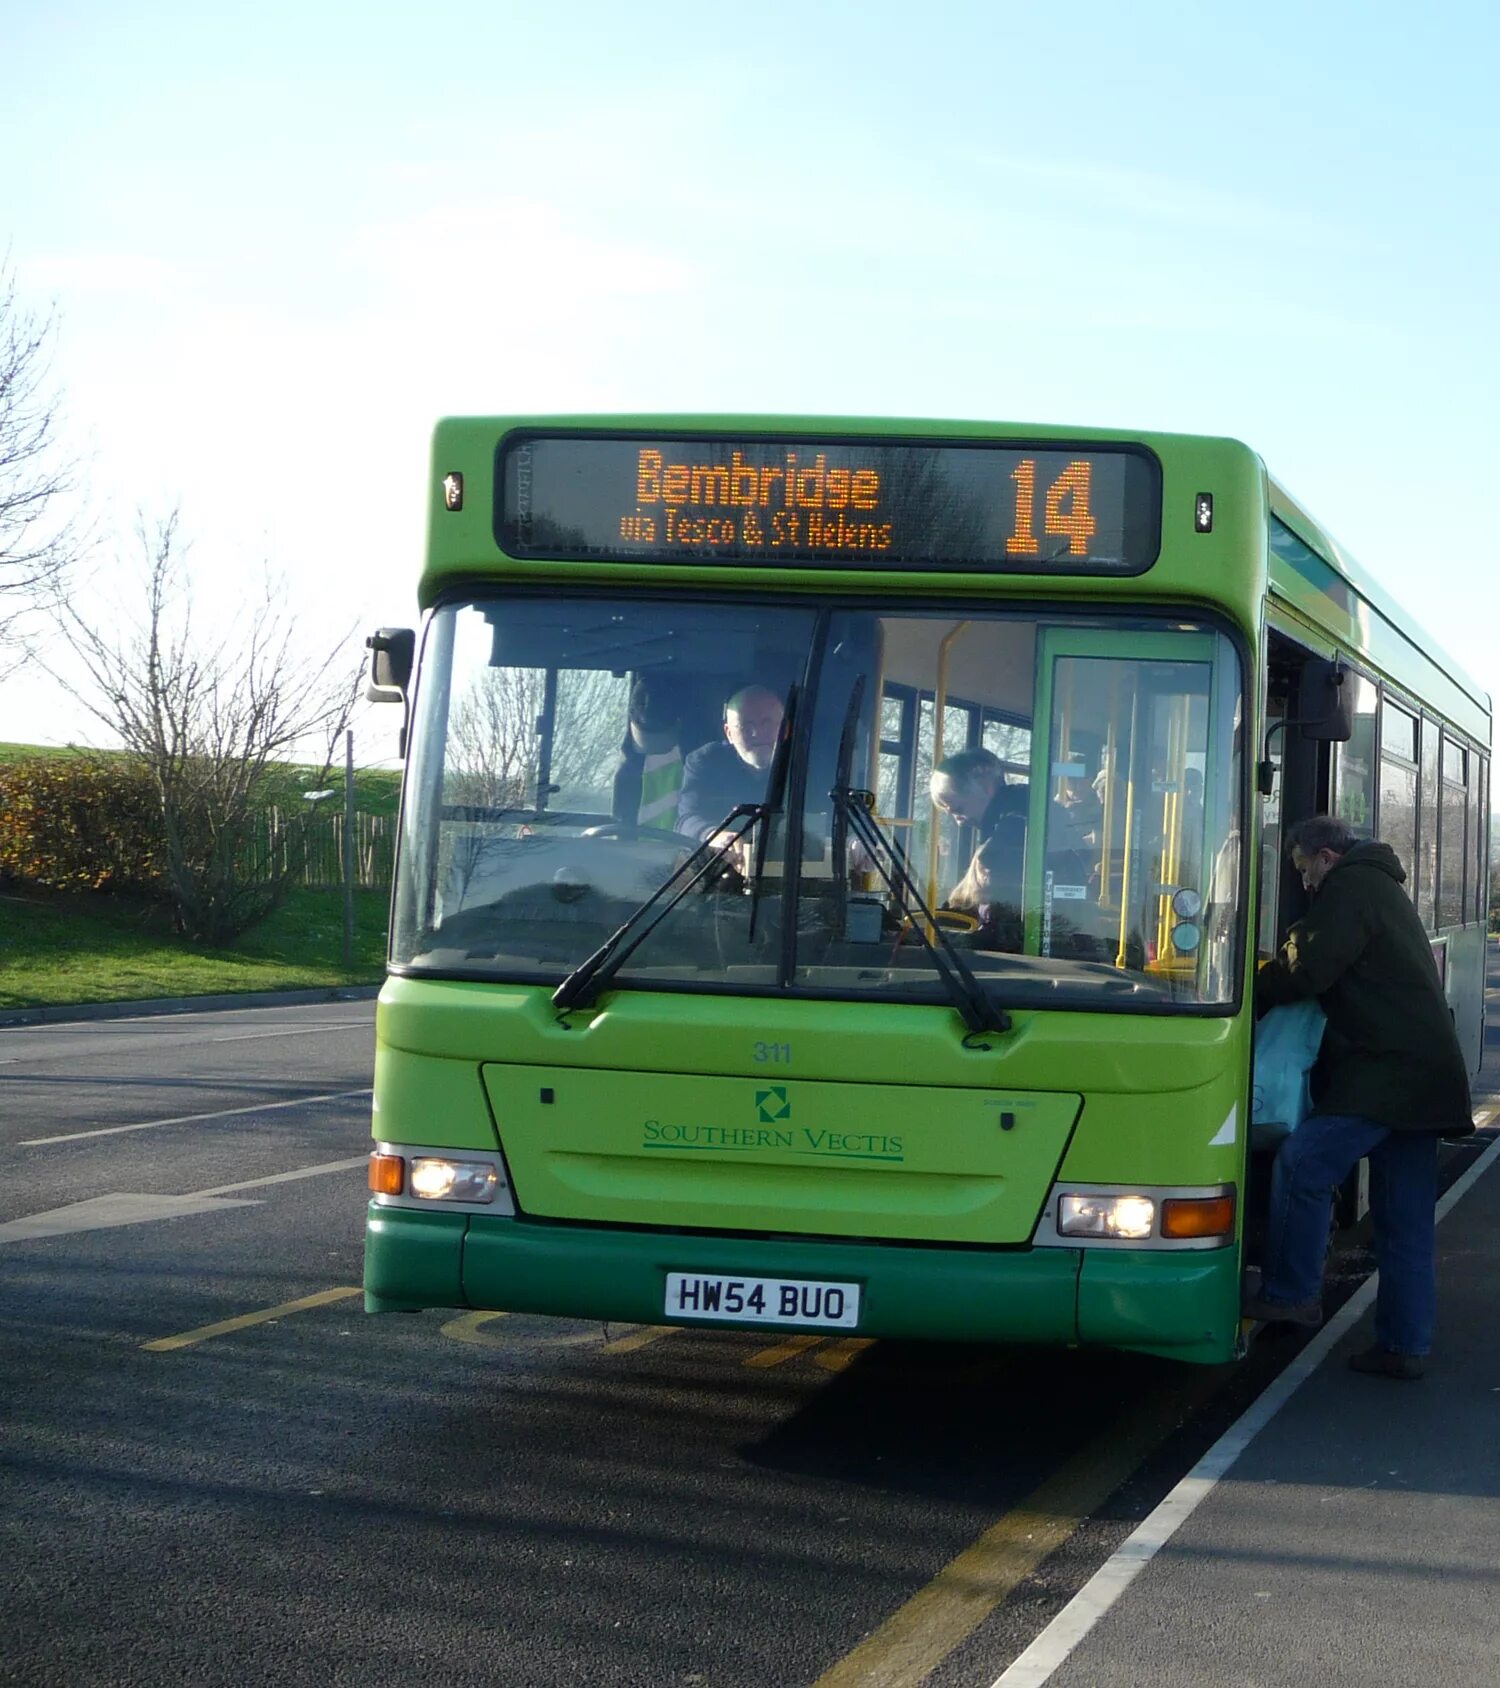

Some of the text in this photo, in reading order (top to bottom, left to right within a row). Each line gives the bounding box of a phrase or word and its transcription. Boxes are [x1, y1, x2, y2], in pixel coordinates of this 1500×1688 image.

[636, 449, 880, 509] Bembridge
[1006, 460, 1096, 554] 14
[620, 508, 893, 549] via Tesco & St Helens
[753, 1041, 792, 1064] 311
[643, 1120, 904, 1153] SOUTHERN VECTIS
[679, 1278, 845, 1320] HW54 BUO
